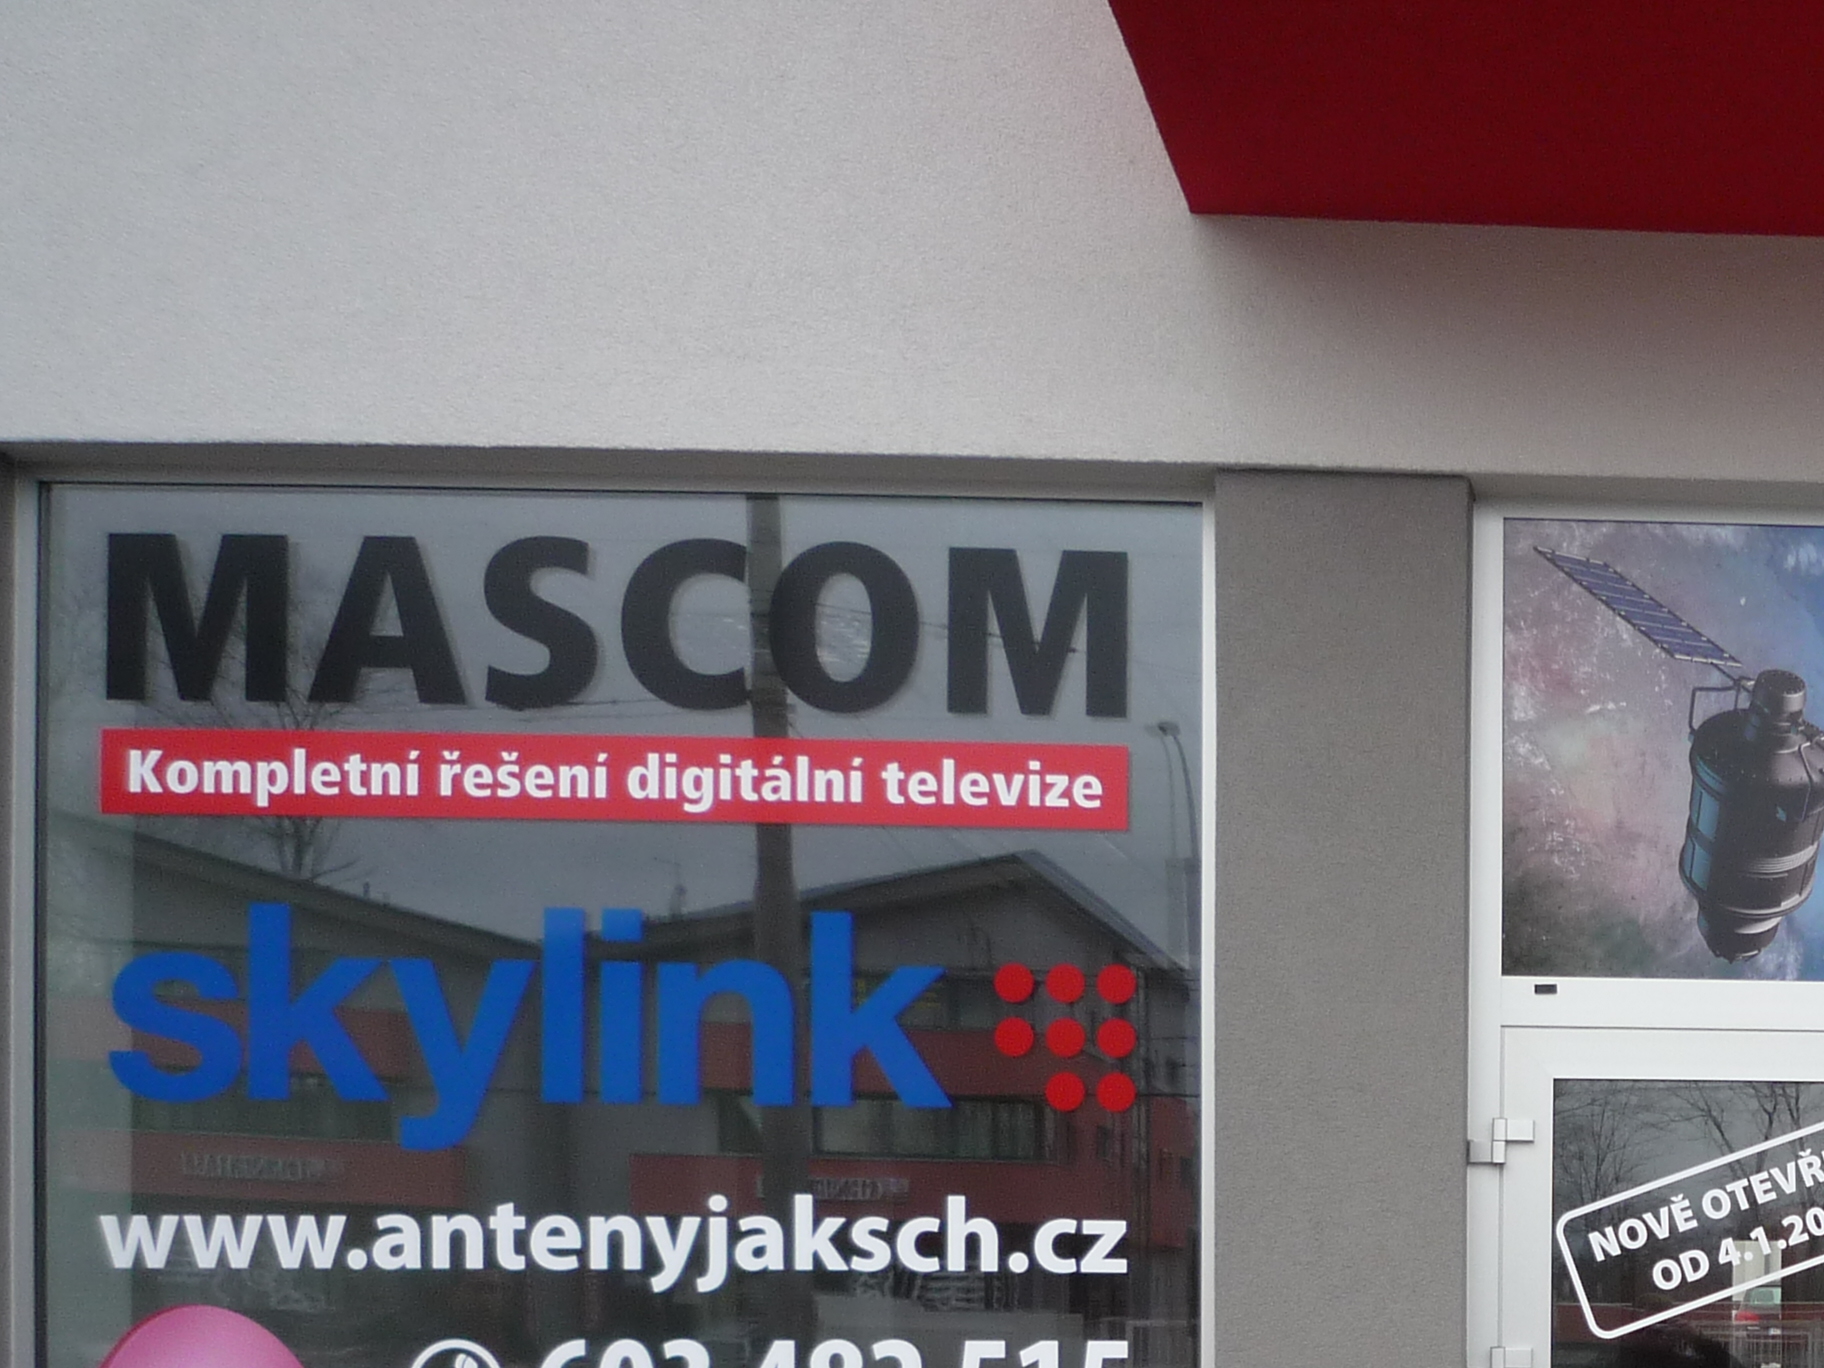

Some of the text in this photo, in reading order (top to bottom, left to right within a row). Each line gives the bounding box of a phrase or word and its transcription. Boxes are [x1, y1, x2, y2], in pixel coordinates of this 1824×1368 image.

[104, 532, 1129, 718] MASCOM
[127, 748, 1102, 812] Kompletní řešení digitální televize
[108, 902, 951, 1150] skylink
[100, 1194, 1128, 1292] www.antenyjaksch.cz
[1588, 1194, 1698, 1262] NOVĚ
[1653, 1250, 1709, 1291] OD
